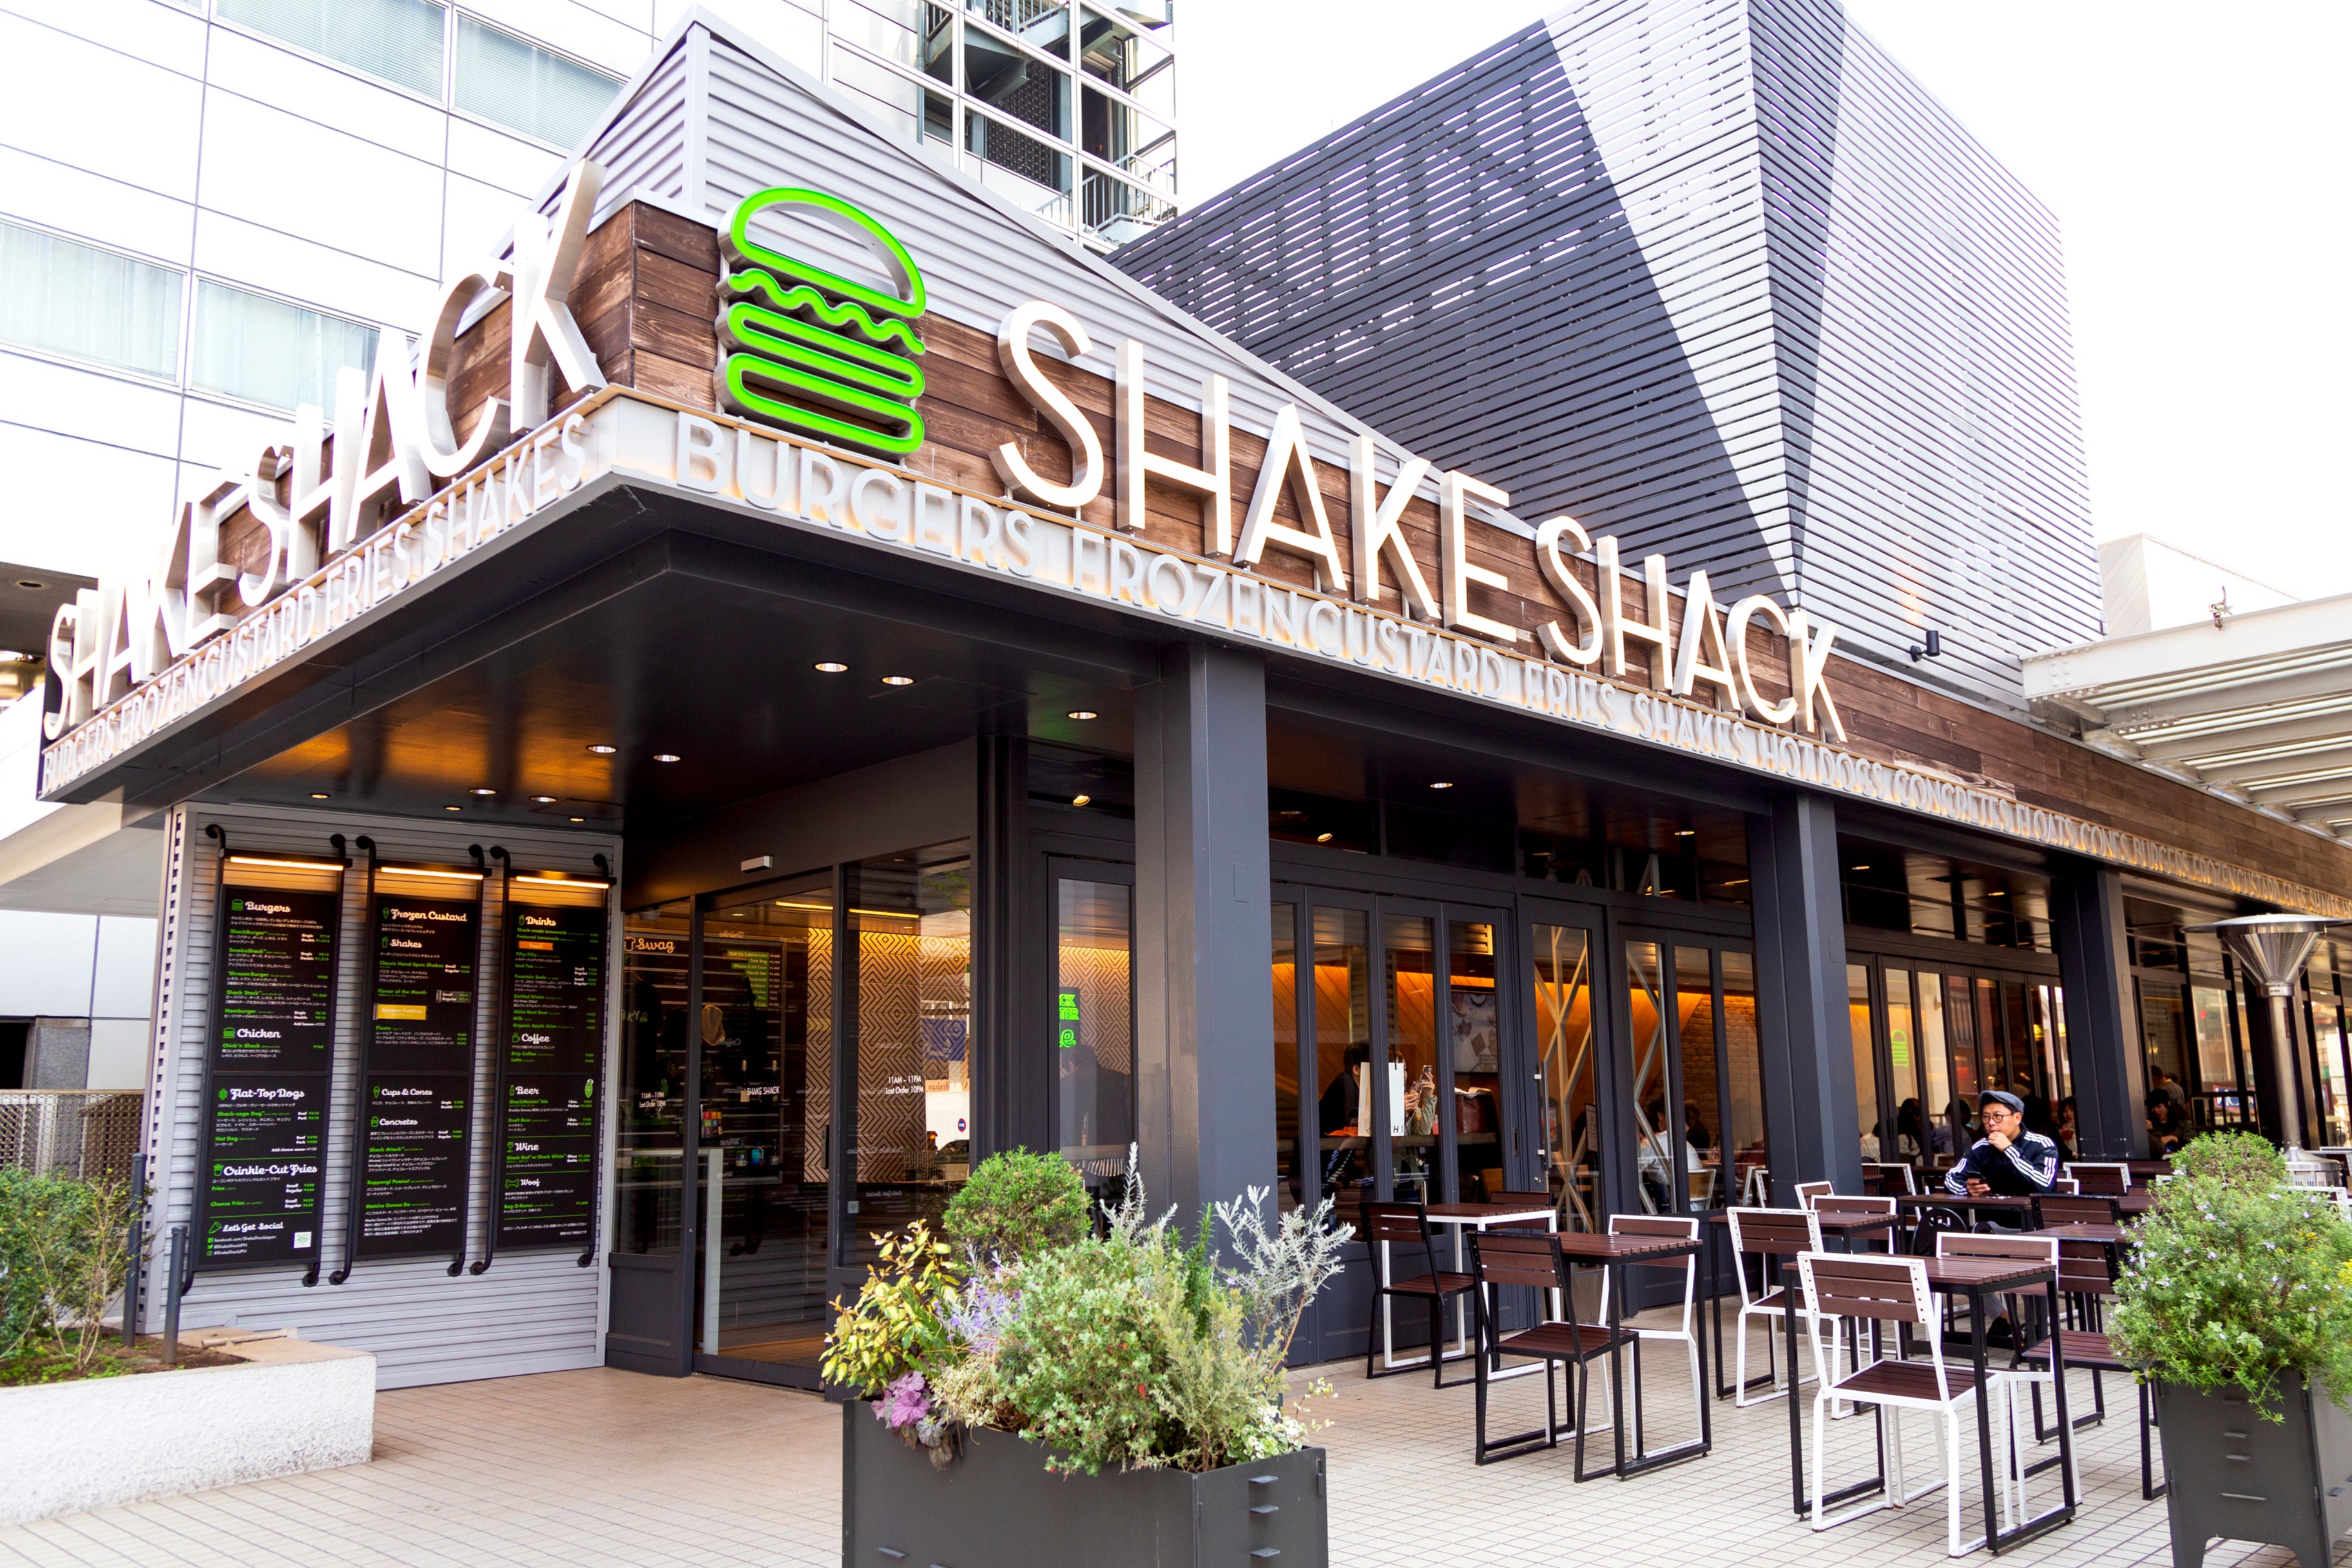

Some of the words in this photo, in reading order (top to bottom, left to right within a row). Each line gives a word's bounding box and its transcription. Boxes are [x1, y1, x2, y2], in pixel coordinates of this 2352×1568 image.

[239, 158, 607, 607] SHACK
[990, 300, 1517, 642] SHAKE
[1537, 515, 1848, 743] SHACK
[42, 711, 117, 795] BURGERS
[325, 522, 412, 631] FRIES
[425, 413, 586, 571] SHAKES
[677, 411, 1038, 577] BURGERS
[1525, 660, 1618, 730] FRIES
[1634, 693, 1748, 765] SHAKES
[1894, 769, 2010, 832] CONCRETES
[2016, 803, 2074, 848] FLOATS
[2080, 823, 2128, 862] CONES
[2133, 837, 2189, 878] BURGERS
[245, 901, 291, 914] Burgers
[390, 908, 427, 921] Frozen
[428, 911, 468, 922] Custard
[525, 916, 556, 926] Drinks
[389, 939, 423, 948] Shakes
[635, 937, 675, 953] Swag
[236, 1029, 282, 1038] Chicken
[521, 1033, 550, 1044] Coffee
[230, 1088, 276, 1101] Flat-Top
[276, 1088, 305, 1100] Dogs
[381, 1088, 401, 1097] Cups
[516, 1086, 539, 1095] Beer
[746, 1087, 762, 1095] SHAKE
[763, 1086, 780, 1095] SHACK
[895, 1085, 910, 1094] Order
[515, 1142, 539, 1151] Wine
[224, 1165, 289, 1176] Crinkle-Cut
[289, 1164, 318, 1176] Fries
[520, 1178, 541, 1187] Woof
[241, 1223, 256, 1232] Get
[258, 1221, 284, 1230] Social
